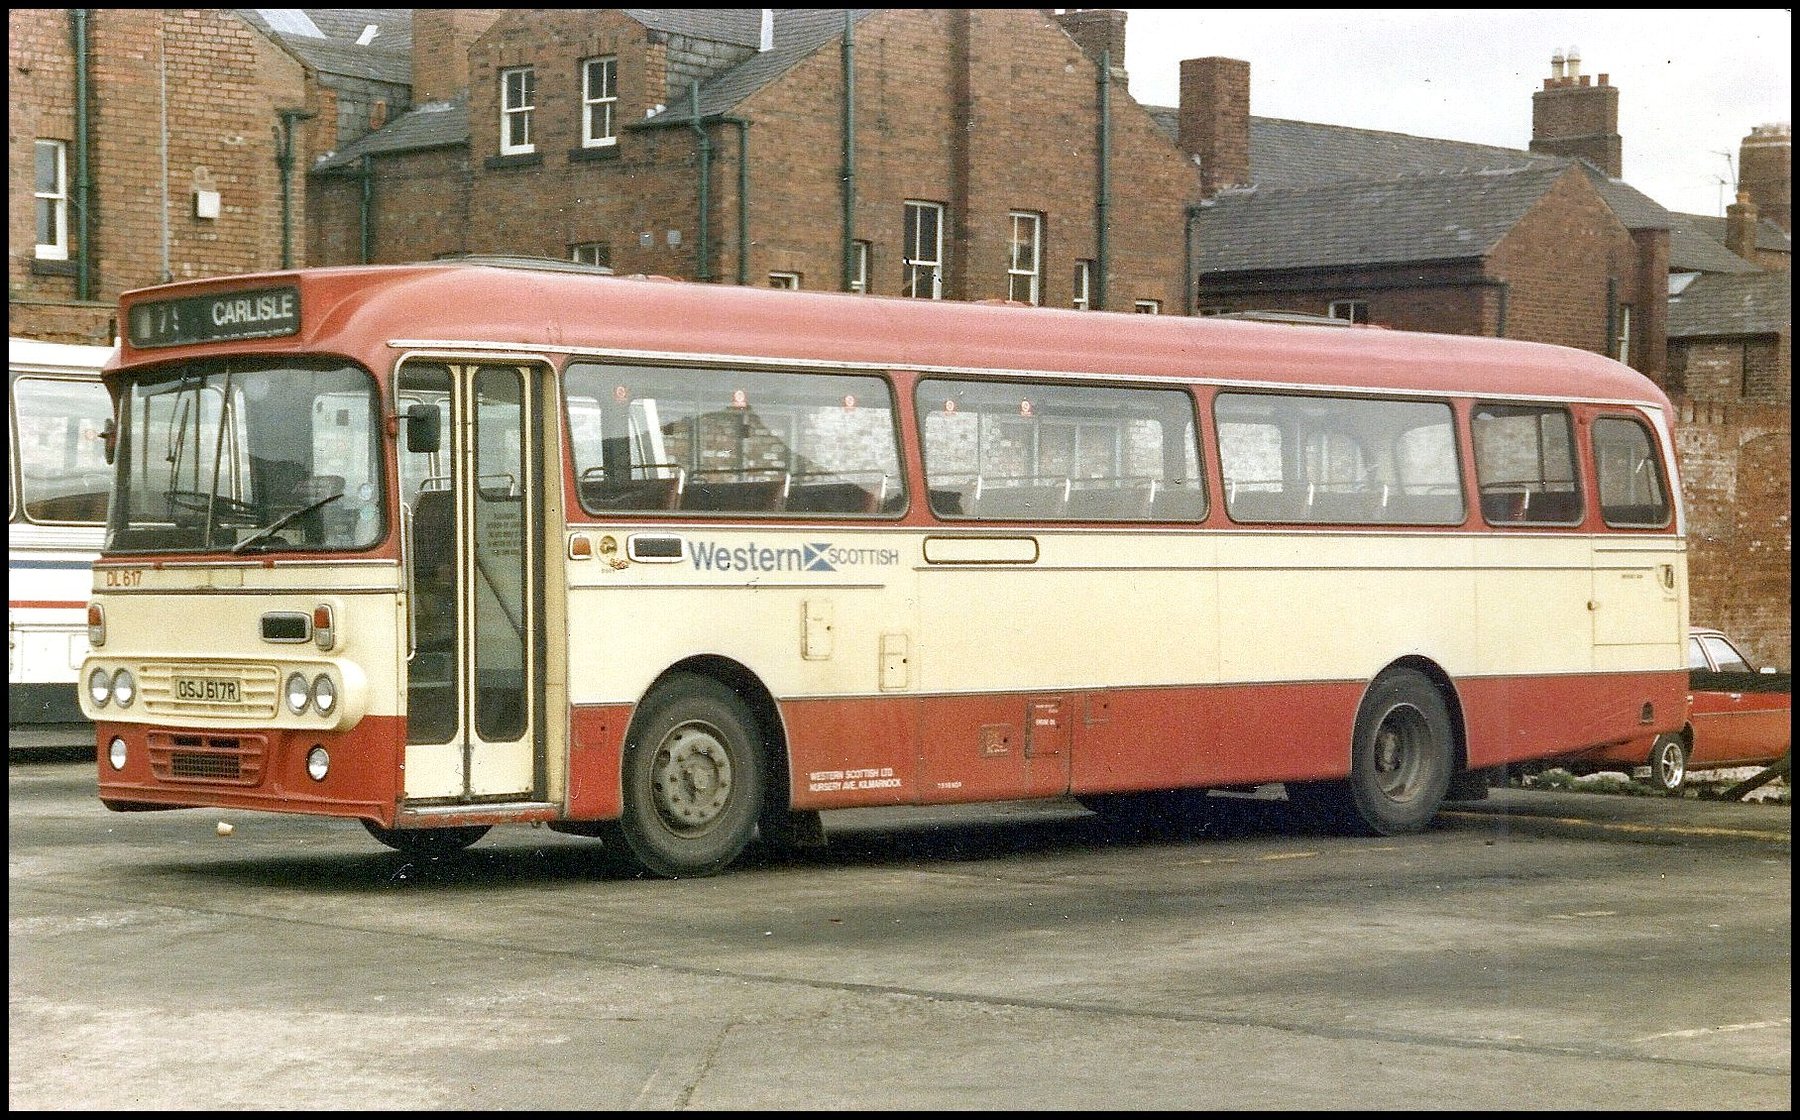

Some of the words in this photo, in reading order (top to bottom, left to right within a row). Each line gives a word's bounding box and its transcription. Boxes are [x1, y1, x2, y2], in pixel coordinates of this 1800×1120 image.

[212, 294, 294, 326] CARLISLE
[688, 541, 802, 571] Western
[829, 548, 899, 565] SCOTTISH
[124, 570, 142, 586] 617
[810, 771, 844, 780] WESTERN
[845, 769, 879, 779] SCOTTISH
